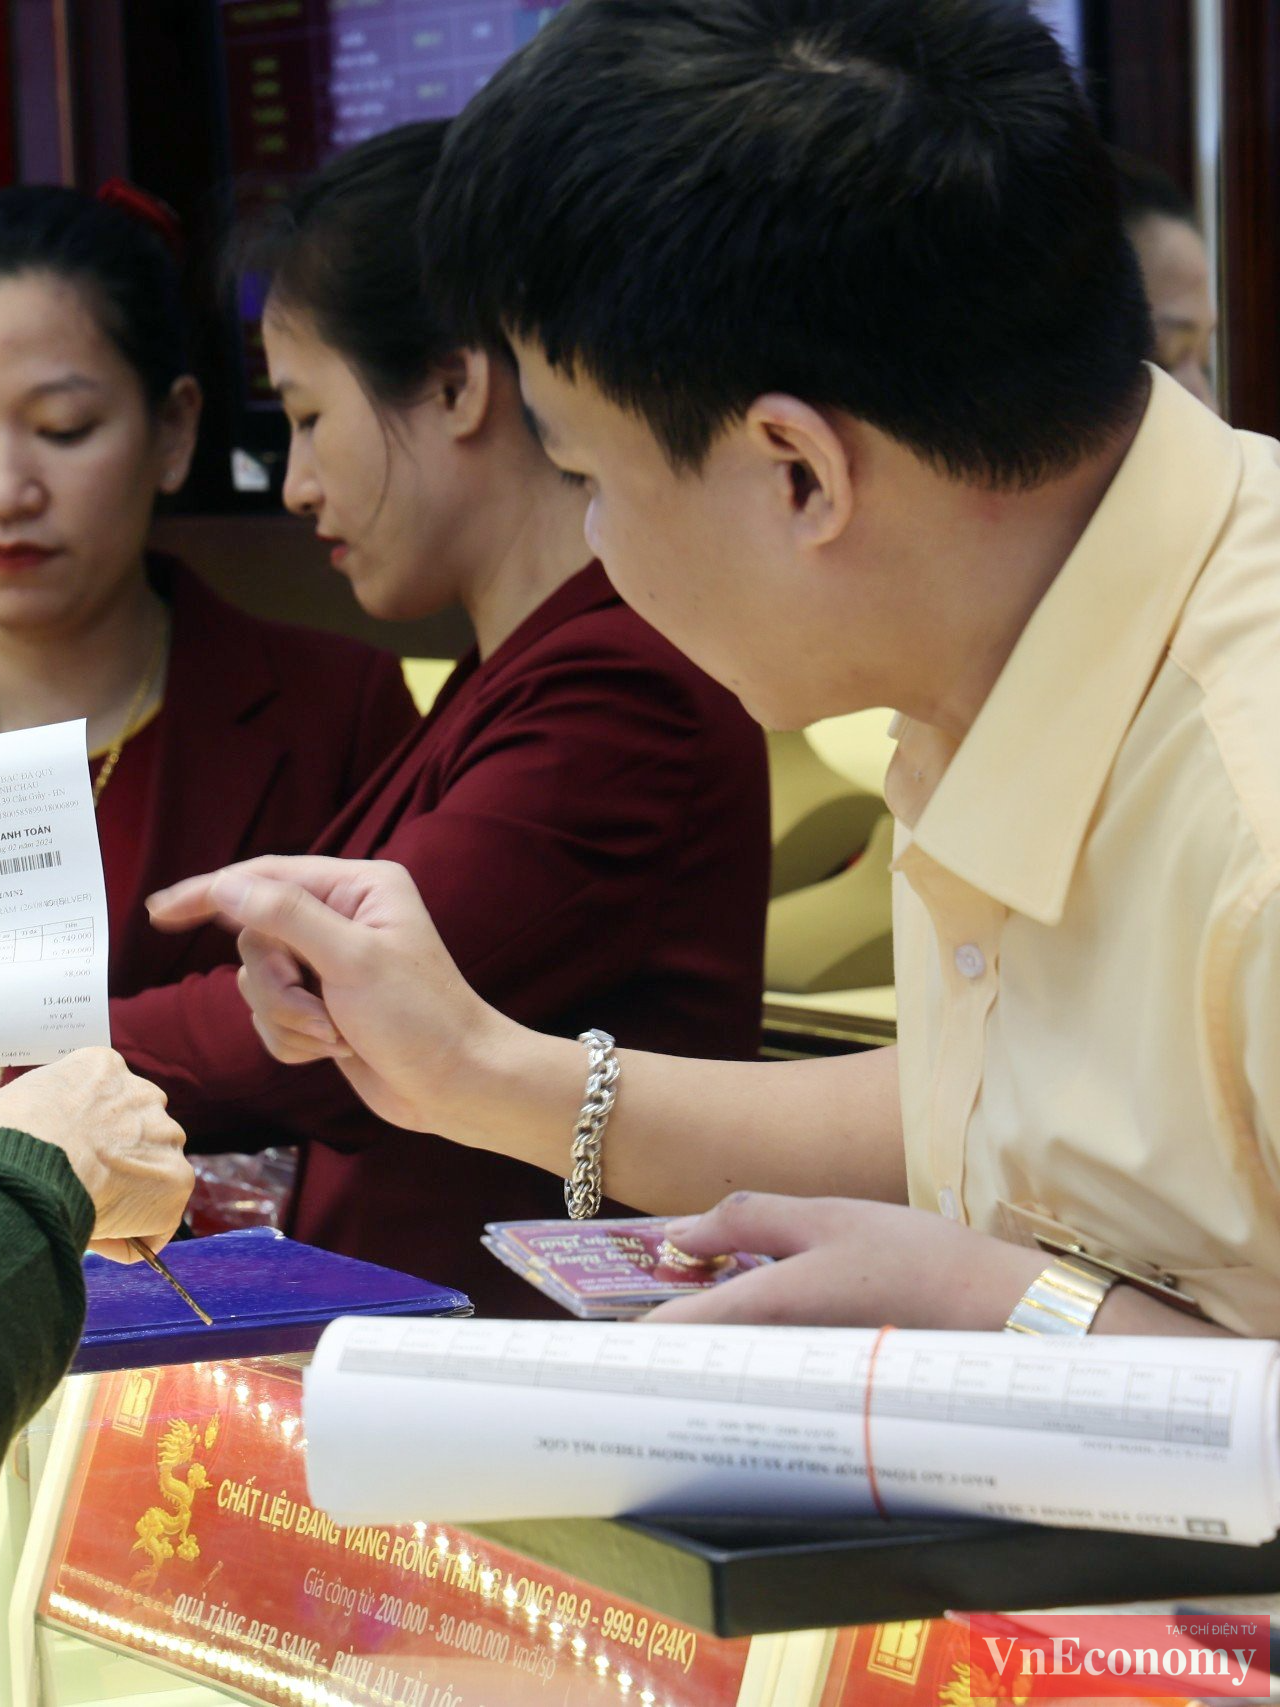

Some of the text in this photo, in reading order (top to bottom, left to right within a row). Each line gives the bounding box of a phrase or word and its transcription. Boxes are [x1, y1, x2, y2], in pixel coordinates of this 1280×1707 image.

[42, 994, 92, 1007] 13.460.000
[217, 1475, 260, 1518] CHẤT
[259, 1489, 296, 1532] LIỆU
[556, 1591, 591, 1629] 99.9
[600, 1606, 649, 1649] 999.9
[647, 1618, 697, 1674] (24K)
[303, 1567, 324, 1599] Giá
[324, 1575, 356, 1618] công
[356, 1588, 376, 1615] từ:
[375, 1593, 429, 1635] 200.000
[435, 1613, 510, 1664] 30.000.000
[171, 1591, 202, 1624] QUÀ
[202, 1600, 247, 1645] TẶNG
[248, 1619, 278, 1654] ĐẸP
[280, 1630, 320, 1665] SANG
[371, 1663, 398, 1697] AN
